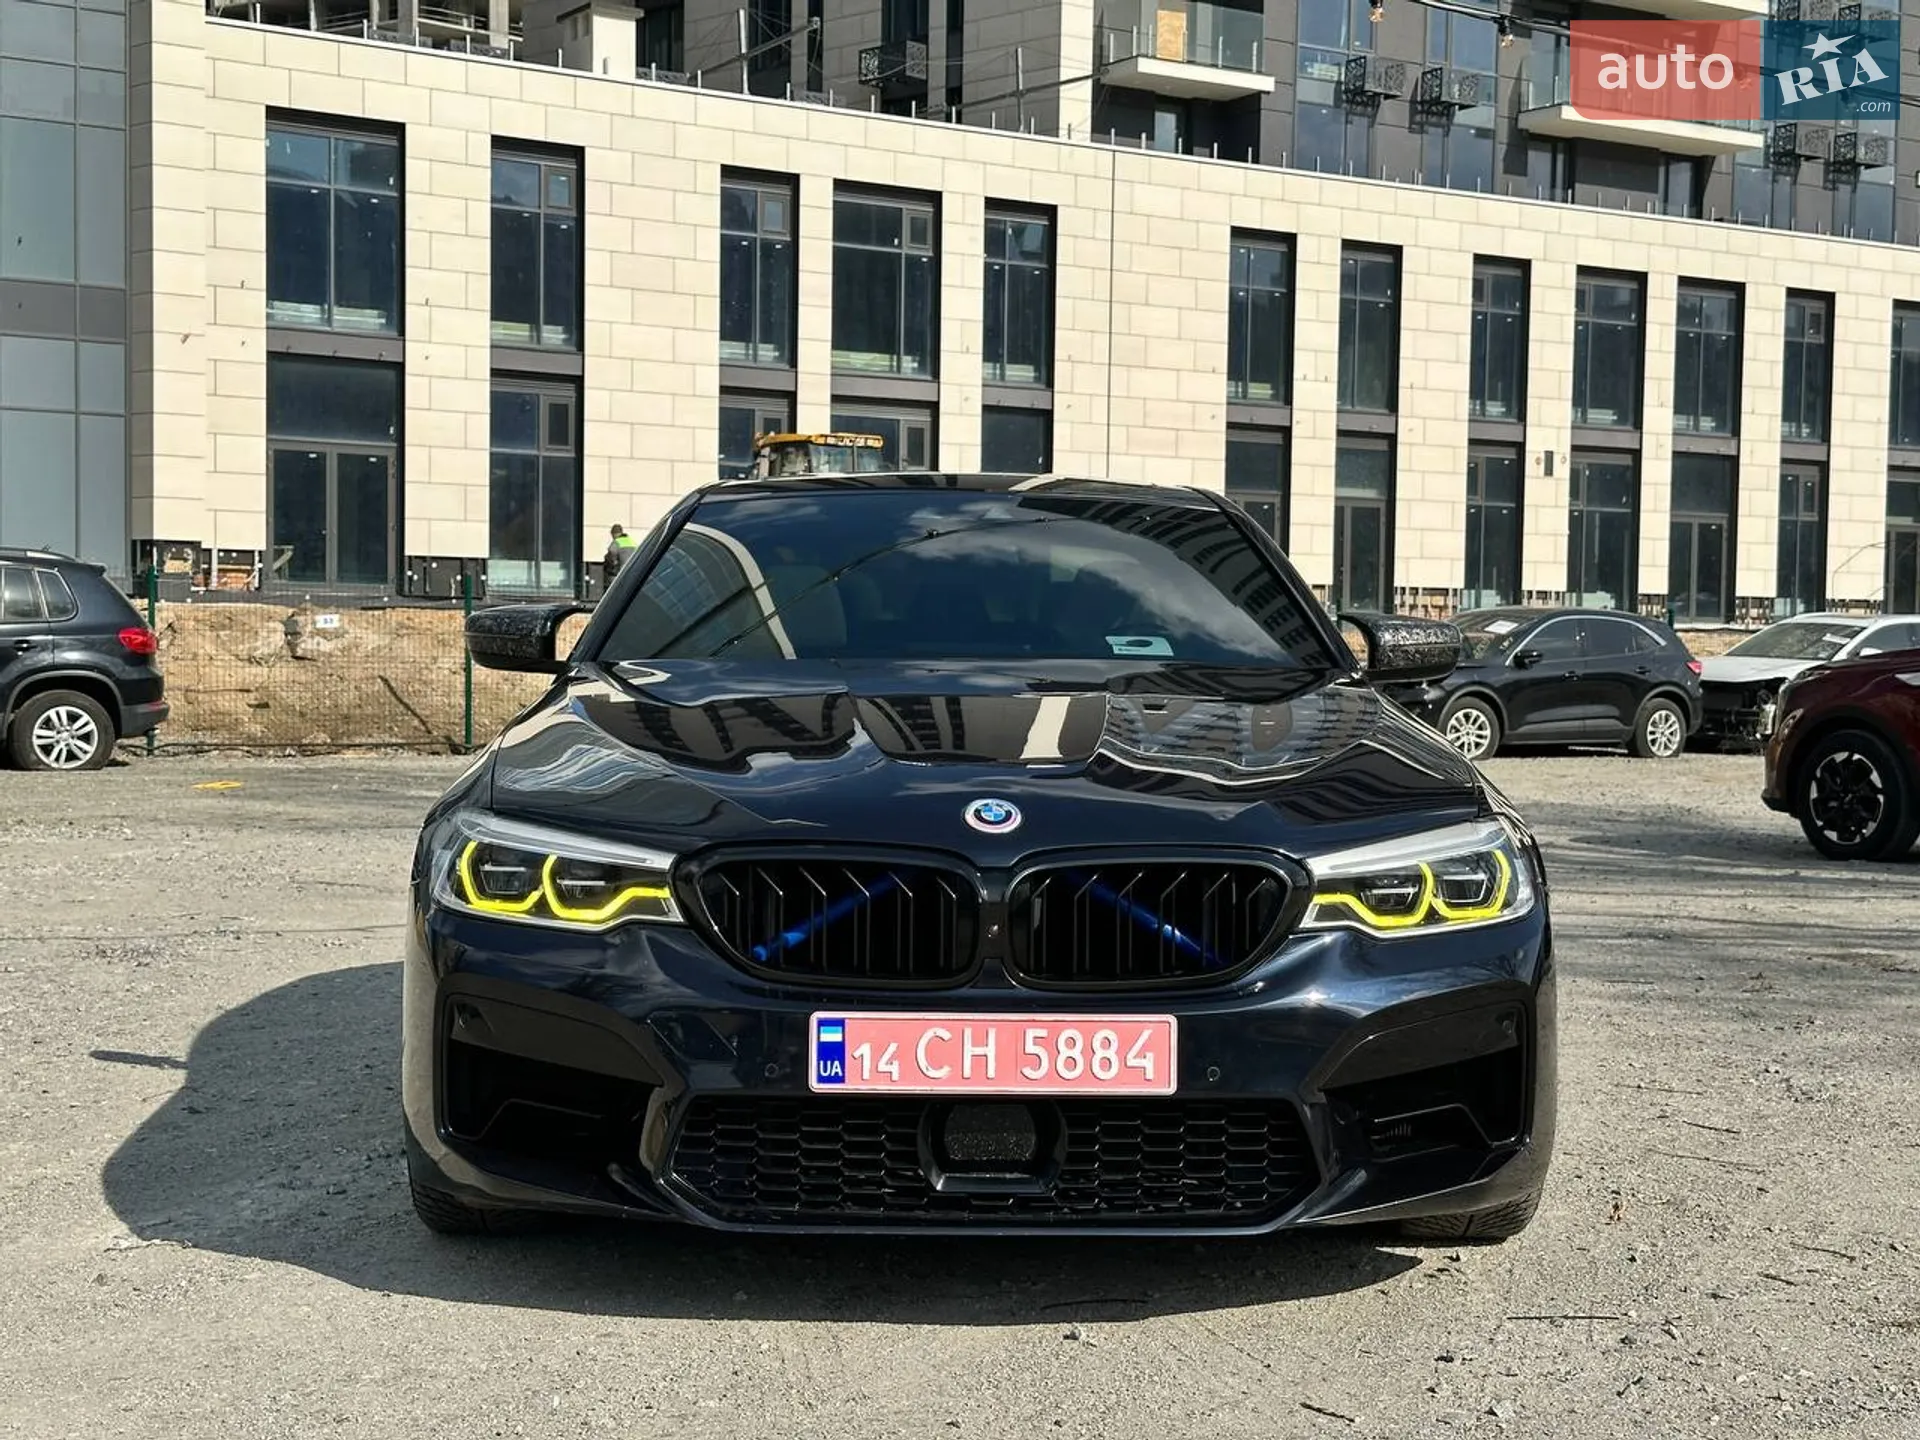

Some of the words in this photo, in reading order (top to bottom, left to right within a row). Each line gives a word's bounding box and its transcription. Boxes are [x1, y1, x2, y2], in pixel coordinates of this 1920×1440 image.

[819, 1061, 842, 1077] UA
[848, 1042, 899, 1081] 14
[915, 1027, 996, 1080] CH
[1020, 1028, 1155, 1081] 5884
